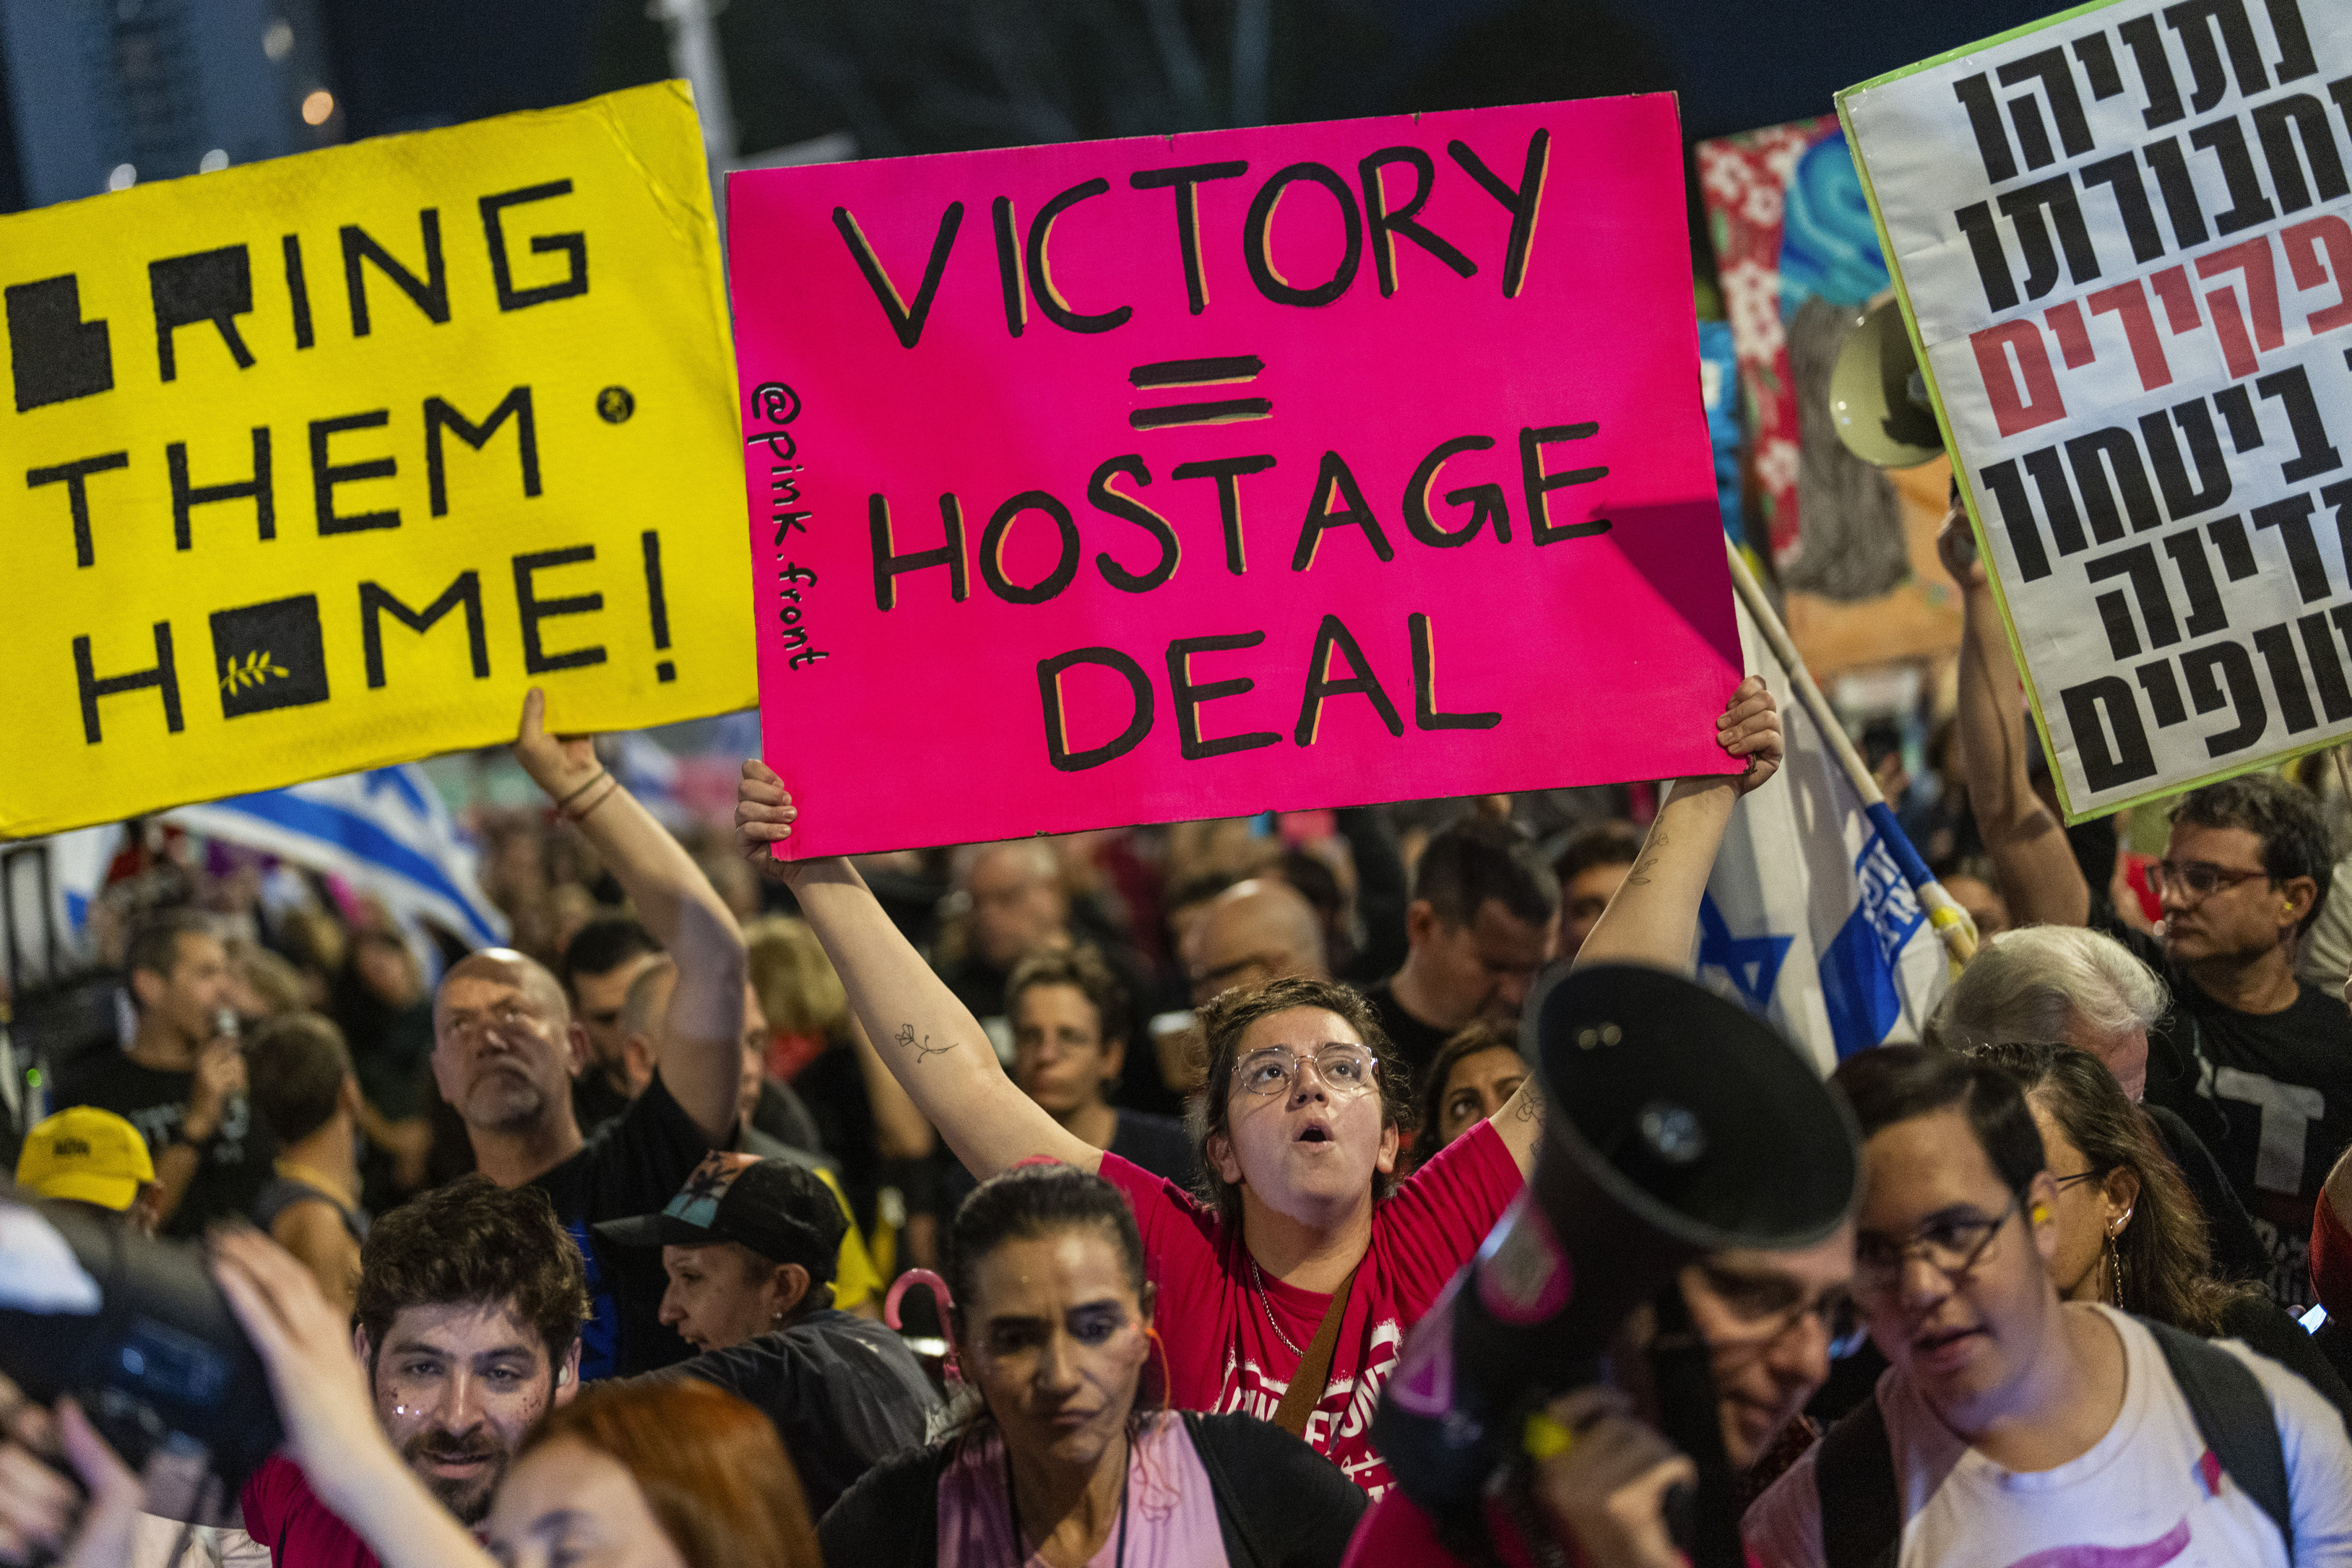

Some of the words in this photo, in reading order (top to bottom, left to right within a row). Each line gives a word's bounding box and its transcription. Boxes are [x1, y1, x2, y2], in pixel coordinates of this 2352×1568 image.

[1952, 0, 2319, 185] נתניהו
[3, 178, 589, 414] BRING
[831, 127, 1550, 349] VICTORY
[26, 386, 543, 568] THEM
[1128, 355, 1274, 431] =
[1979, 364, 2343, 583] ביטחון
[746, 381, 830, 671] @pink.front
[868, 421, 1615, 613] HOSTAGE
[1036, 612, 1503, 773] DEAL
